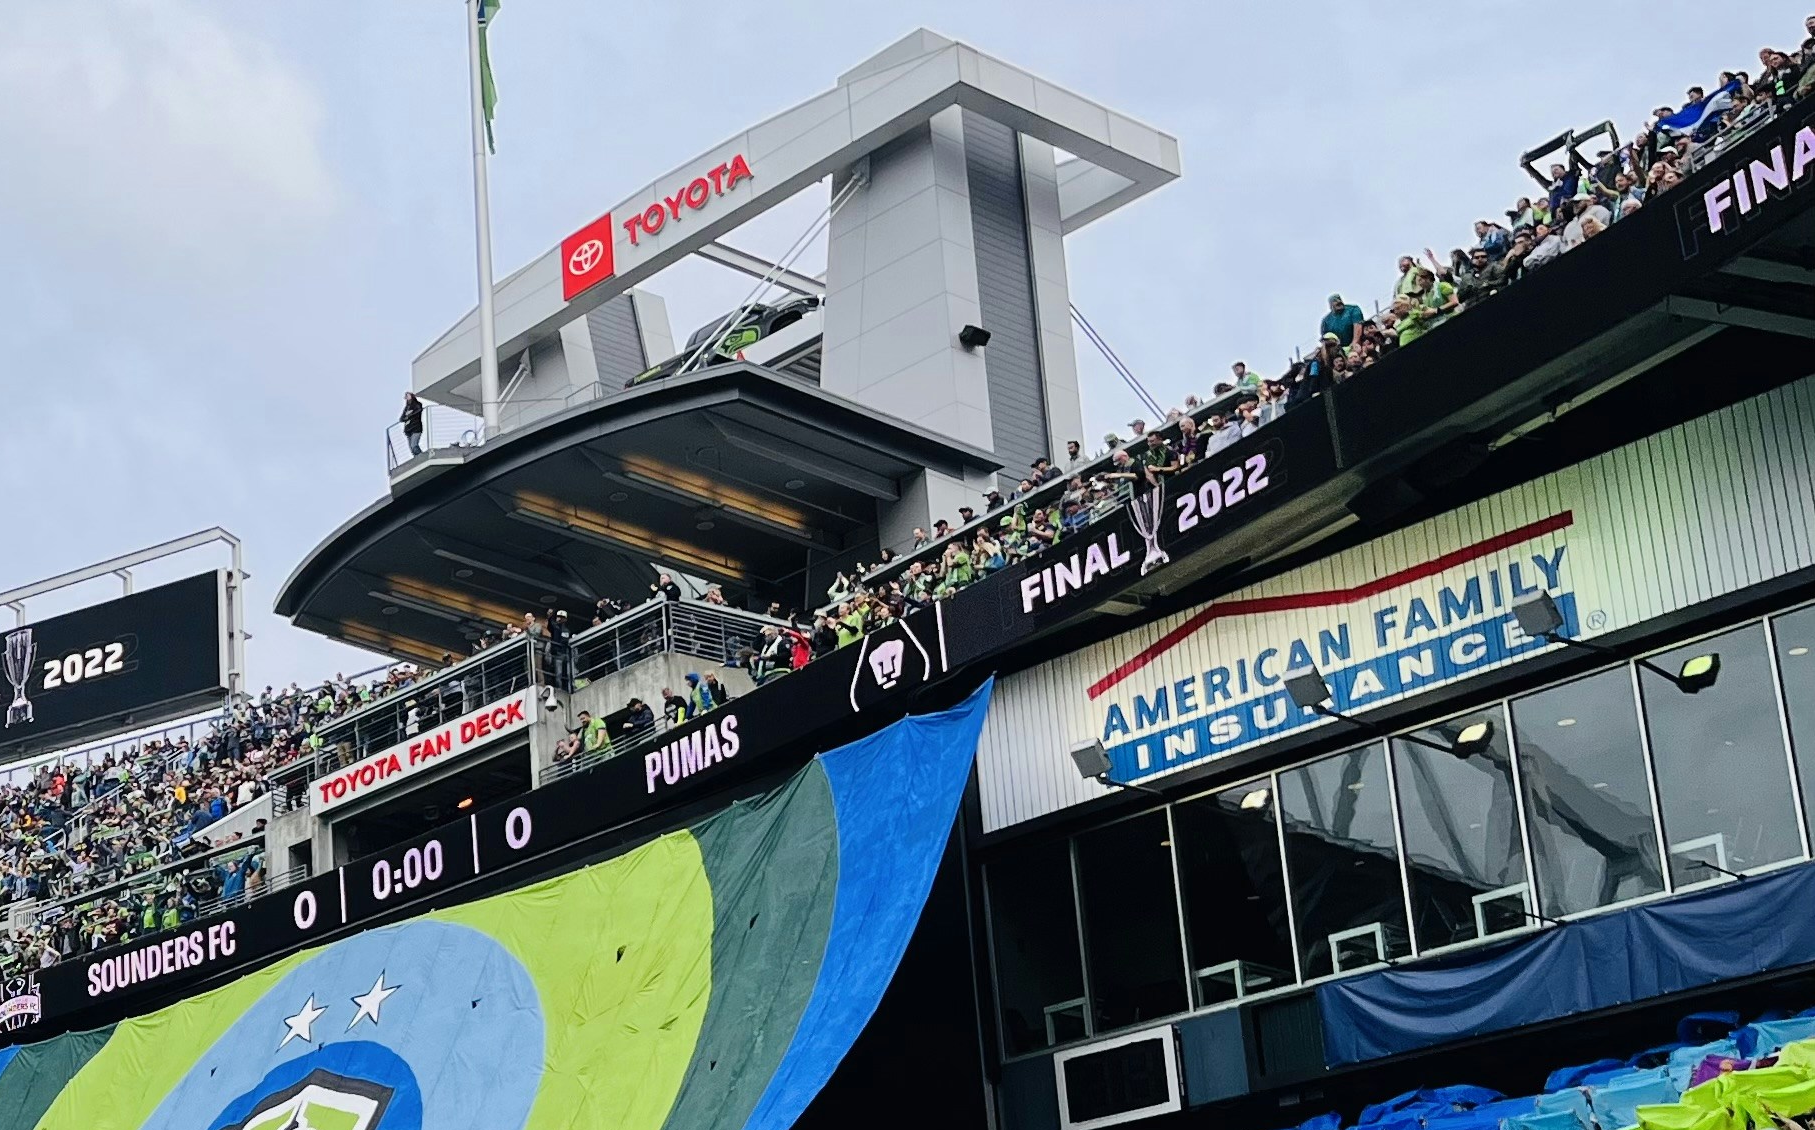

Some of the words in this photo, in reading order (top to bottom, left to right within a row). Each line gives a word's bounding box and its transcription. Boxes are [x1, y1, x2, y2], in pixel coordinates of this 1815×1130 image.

[623, 154, 754, 246] TOYOTA
[1020, 532, 1130, 614] FINAL
[1176, 453, 1269, 533] 2022
[43, 642, 123, 690] 2022
[1103, 623, 1350, 741] AMERICAN
[1375, 547, 1567, 648] FAMILY
[319, 754, 402, 804] TOYOTA
[409, 731, 451, 767] FAN
[460, 699, 524, 744] DECK
[645, 714, 740, 794] PUMAS
[505, 806, 532, 850] 0
[372, 839, 443, 900] 0:00
[293, 890, 317, 930] 0
[87, 930, 204, 998] SOUNDERS
[209, 920, 236, 961] FC
